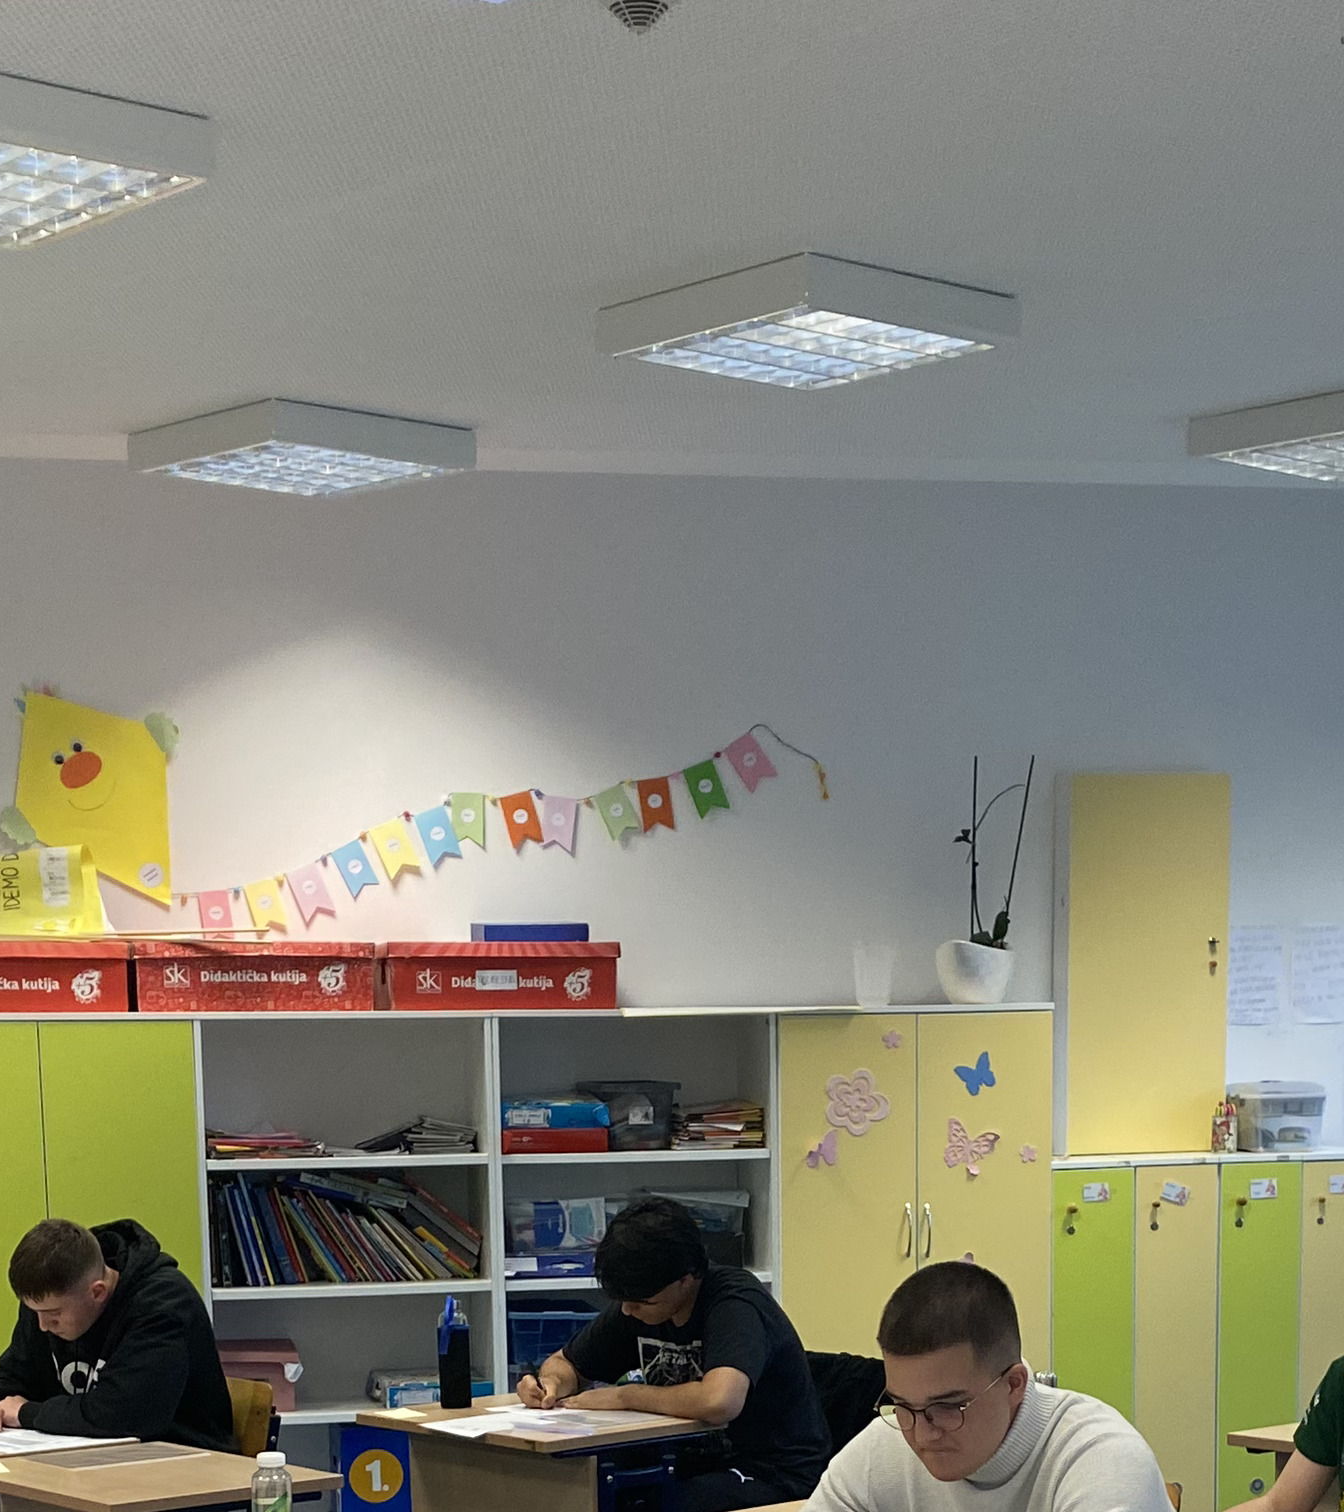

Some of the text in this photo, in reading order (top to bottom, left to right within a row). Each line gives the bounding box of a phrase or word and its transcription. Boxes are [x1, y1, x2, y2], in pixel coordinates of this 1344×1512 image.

[1, 866, 22, 912] IDEMO
[22, 977, 60, 993] kutija
[200, 969, 268, 983] Didaktička
[271, 969, 307, 985] kutija
[519, 976, 554, 991] kutija
